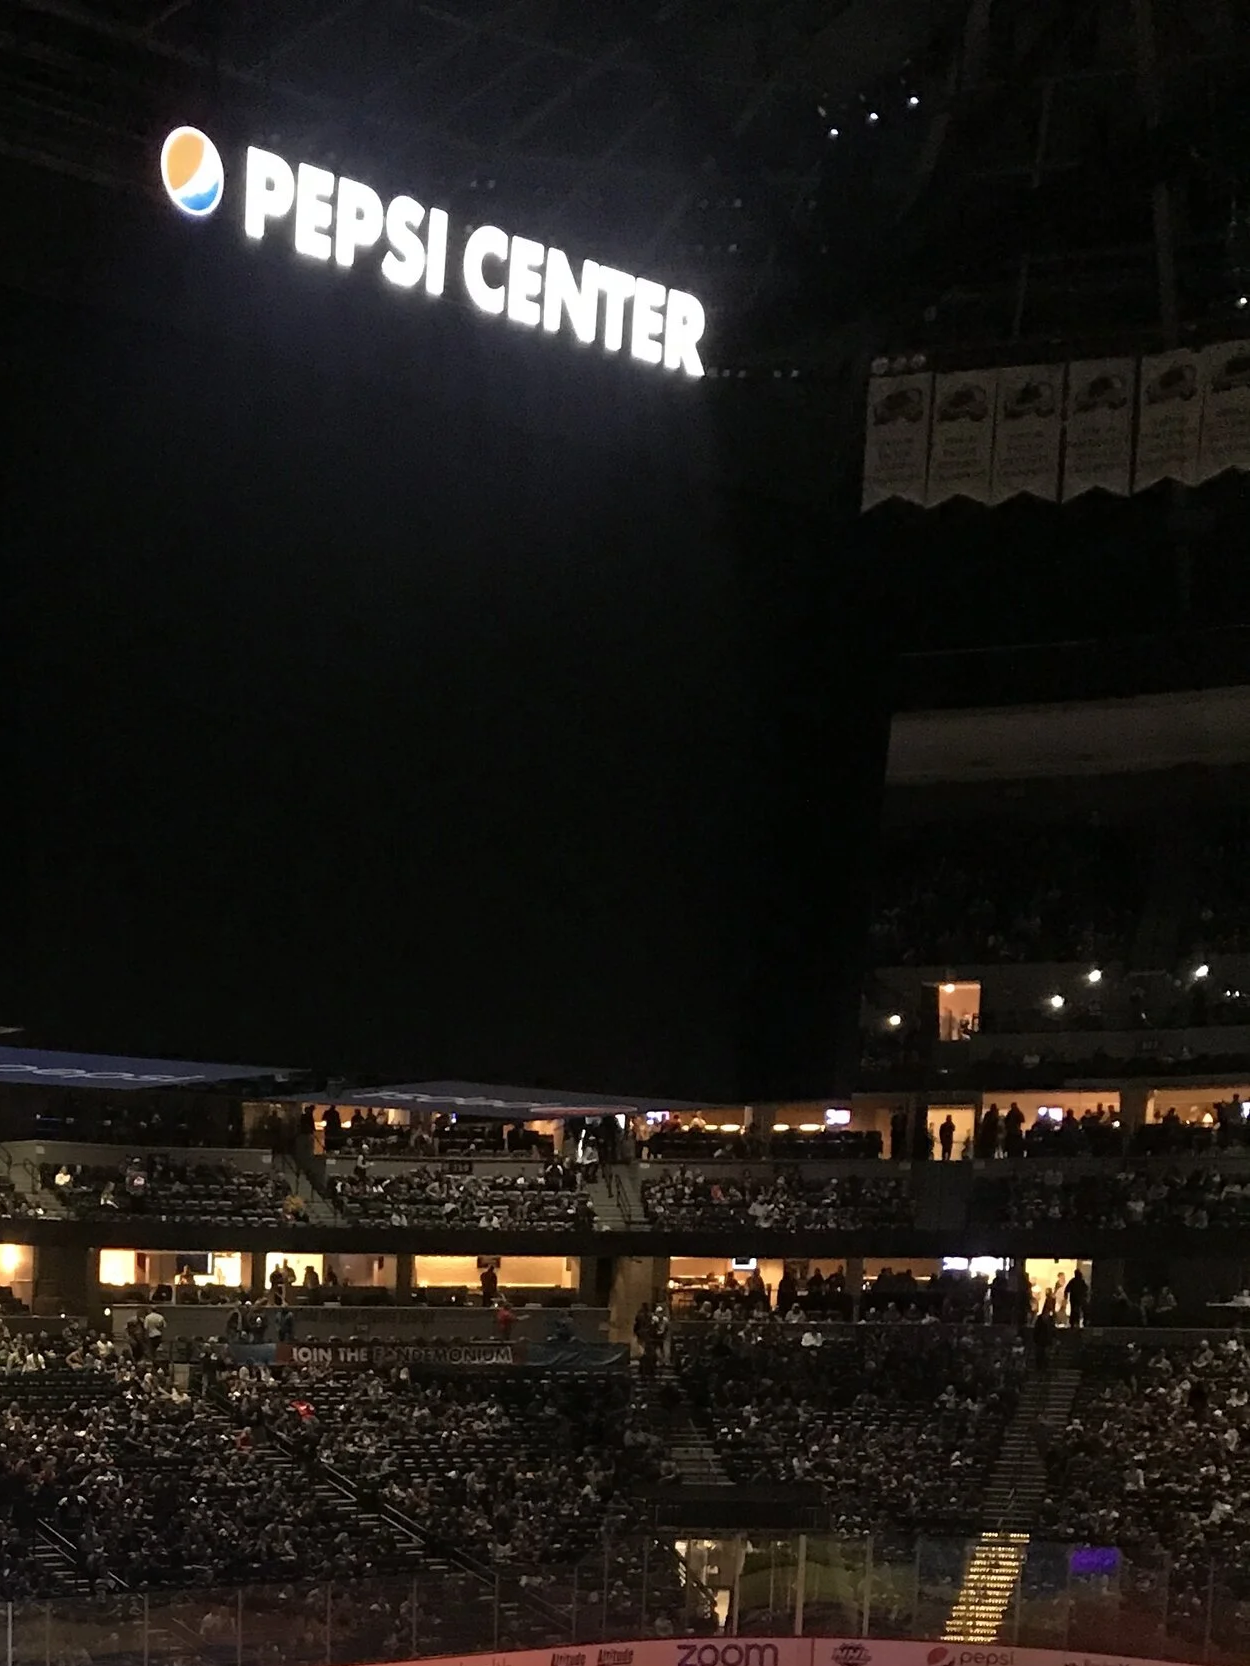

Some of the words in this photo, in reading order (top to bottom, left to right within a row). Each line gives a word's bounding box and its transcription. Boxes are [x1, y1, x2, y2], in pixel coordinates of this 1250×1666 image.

[245, 145, 449, 296] PEPSI
[463, 225, 706, 376] CENTER
[291, 1346, 333, 1364] JOIN
[338, 1346, 368, 1363] THE
[373, 1344, 513, 1365] PANDEMONIUM
